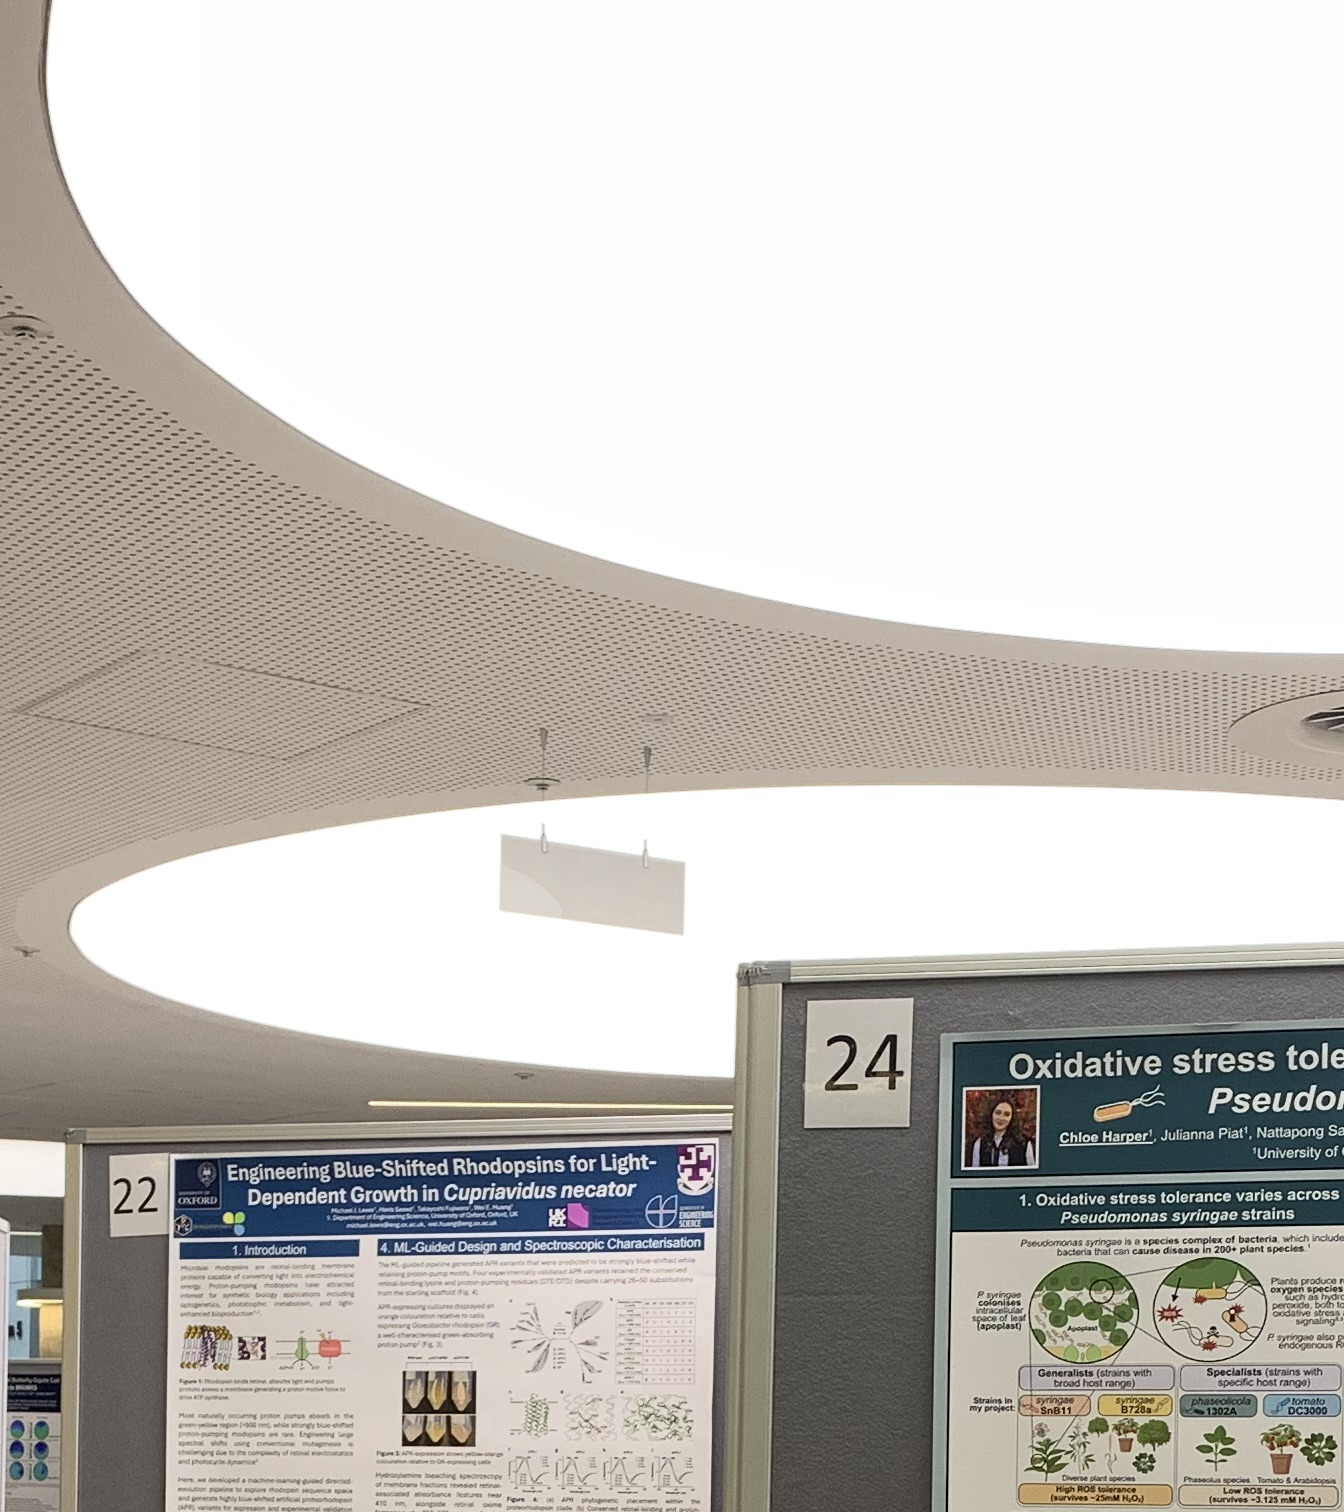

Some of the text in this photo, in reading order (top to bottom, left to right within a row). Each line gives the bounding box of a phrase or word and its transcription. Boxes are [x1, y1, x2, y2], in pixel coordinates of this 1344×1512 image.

[824, 1034, 905, 1092] 24
[1009, 1050, 1161, 1079] Oxidative
[1172, 1048, 1275, 1074] stress
[227, 1153, 657, 1184] Engineering Blue-Shifted Rhodopsins for Light-
[114, 1177, 158, 1214] 22
[178, 1196, 218, 1205] OXFORD
[248, 1181, 637, 1209] Dependent Growth in Cupriavidus necator
[1019, 1188, 1339, 1206] 1. Oxidative stress tolerance varies across
[1060, 1207, 1294, 1224] Pseudomonas syringae strains
[232, 1244, 306, 1255] 1. Introduction
[380, 1237, 701, 1253] 4. ML-Guided Design and Spectroscopic Characterisation
